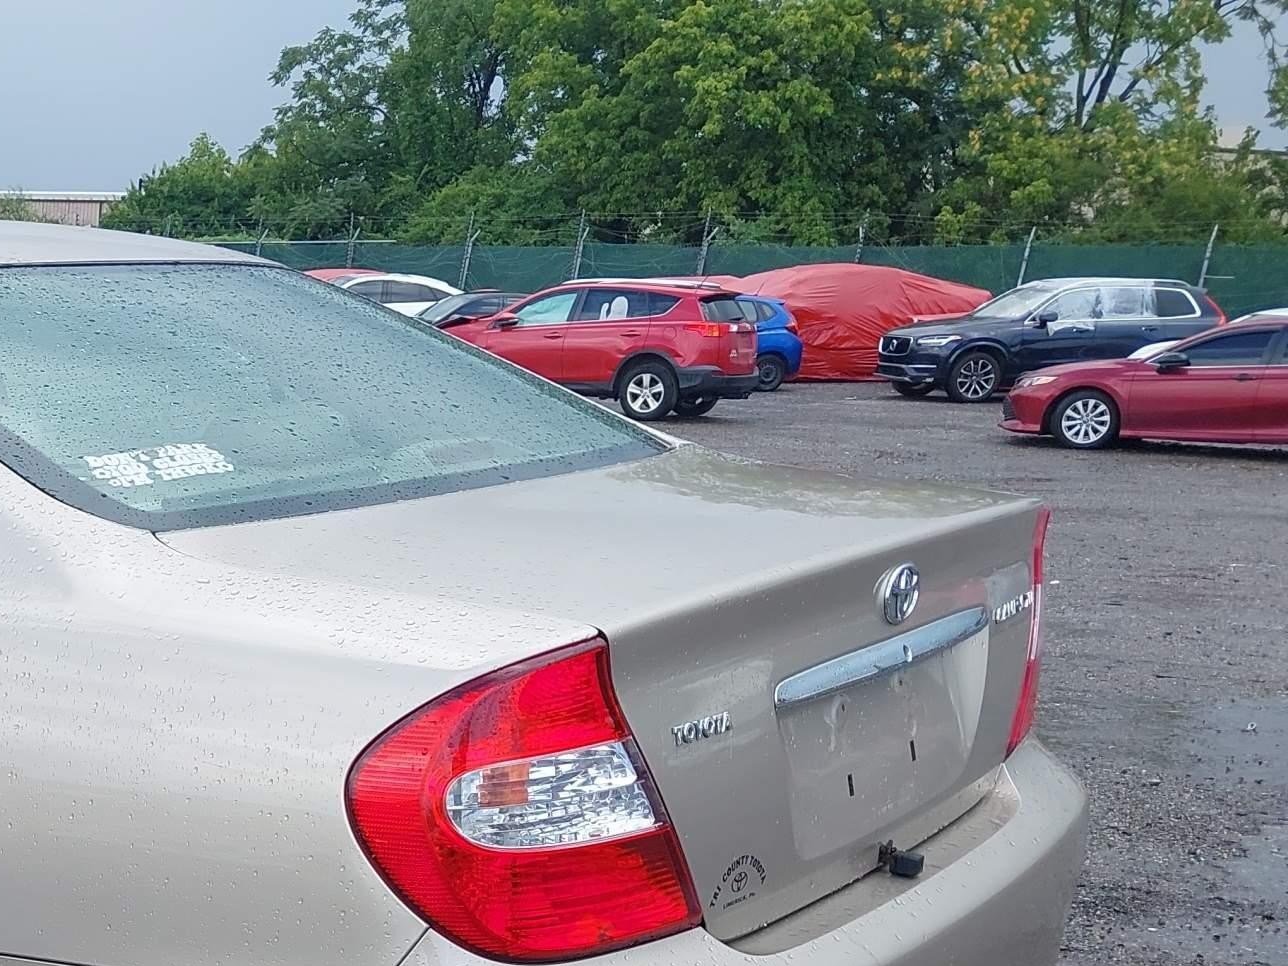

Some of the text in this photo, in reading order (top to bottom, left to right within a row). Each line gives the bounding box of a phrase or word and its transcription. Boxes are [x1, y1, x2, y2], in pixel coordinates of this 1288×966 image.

[83, 443, 219, 467] DON'T PARK
[672, 711, 732, 746] TOYOTA
[709, 854, 767, 908] TRI COUNTY TOYOTA
